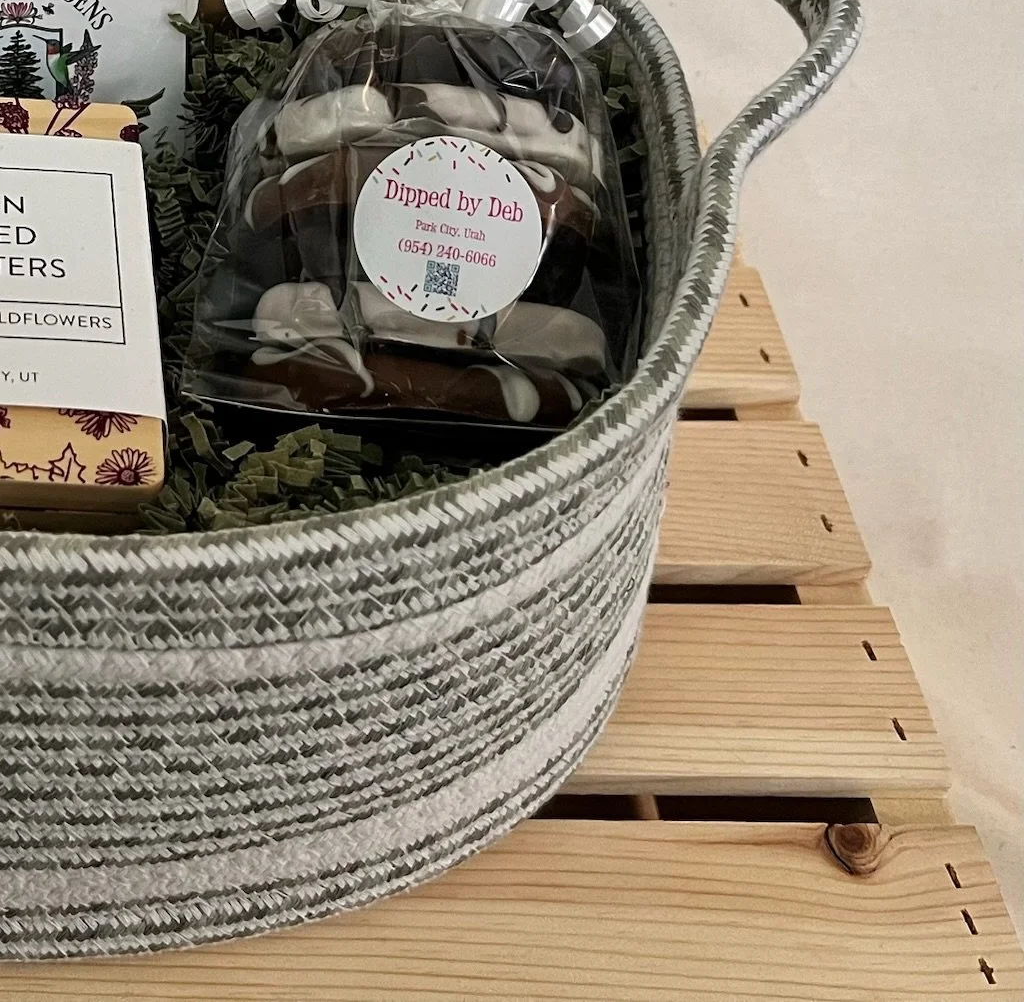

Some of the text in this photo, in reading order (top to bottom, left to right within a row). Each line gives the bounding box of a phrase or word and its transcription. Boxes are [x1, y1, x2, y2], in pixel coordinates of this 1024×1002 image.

[384, 178, 524, 222] Dipped by Deb
[415, 219, 437, 233] Park
[464, 227, 486, 241] Utah
[398, 238, 497, 267] (954) 240-6066
[19, 371, 39, 383] UT
